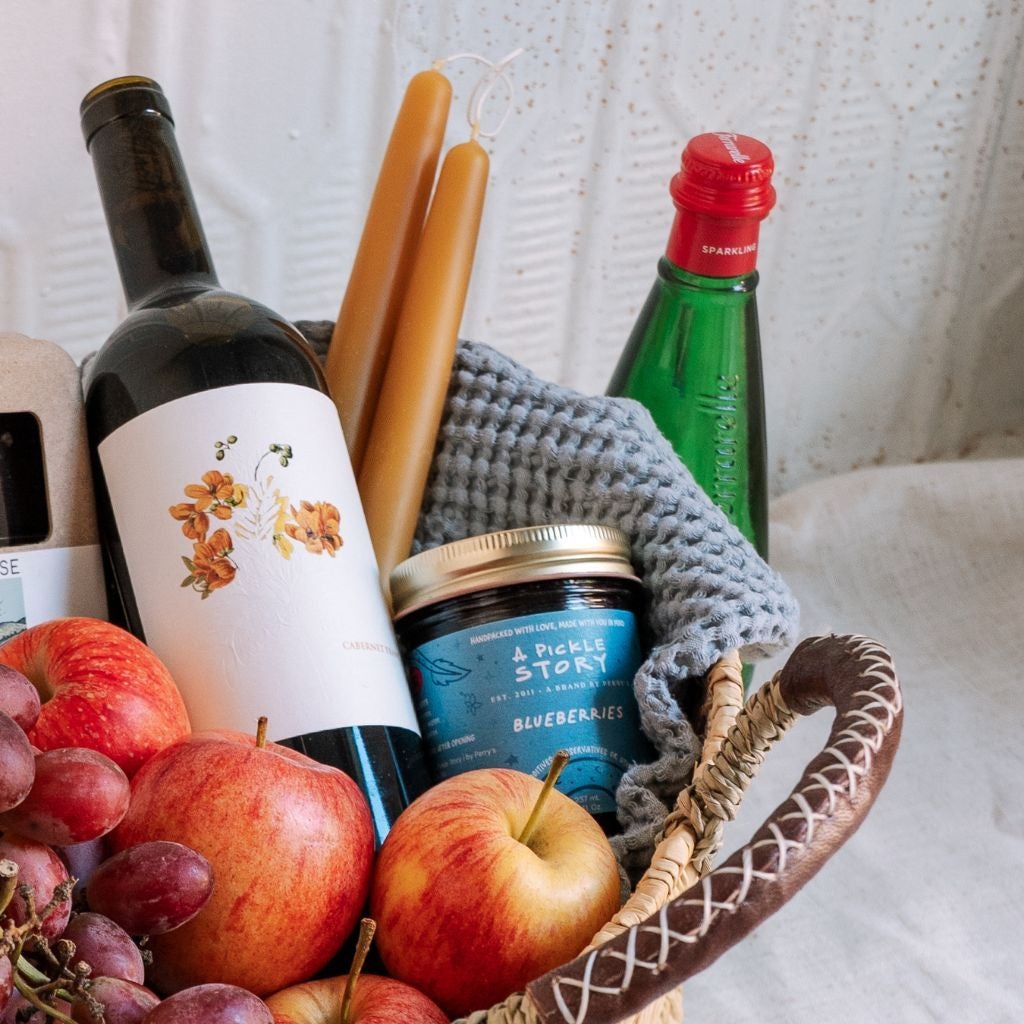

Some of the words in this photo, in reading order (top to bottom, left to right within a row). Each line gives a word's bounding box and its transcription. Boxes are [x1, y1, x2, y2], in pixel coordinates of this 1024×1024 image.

[701, 242, 756, 256] SPARKLING
[470, 629, 513, 645] HANDPACKED
[514, 624, 534, 635] WITH
[535, 622, 557, 632] LOVE,
[558, 620, 577, 629] MADE
[578, 619, 595, 627] WITH
[595, 618, 607, 627] YOU
[511, 646, 528, 664] A
[514, 653, 607, 683] STORY
[490, 694, 511, 704] EST.
[515, 688, 535, 699] 2011
[545, 685, 552, 693] A
[555, 680, 586, 692] BRAND
[589, 680, 600, 688] BY
[513, 705, 624, 733] BLUEBERRIES
[531, 755, 553, 777] DITIVES
[567, 744, 608, 756] SERVATIVES
